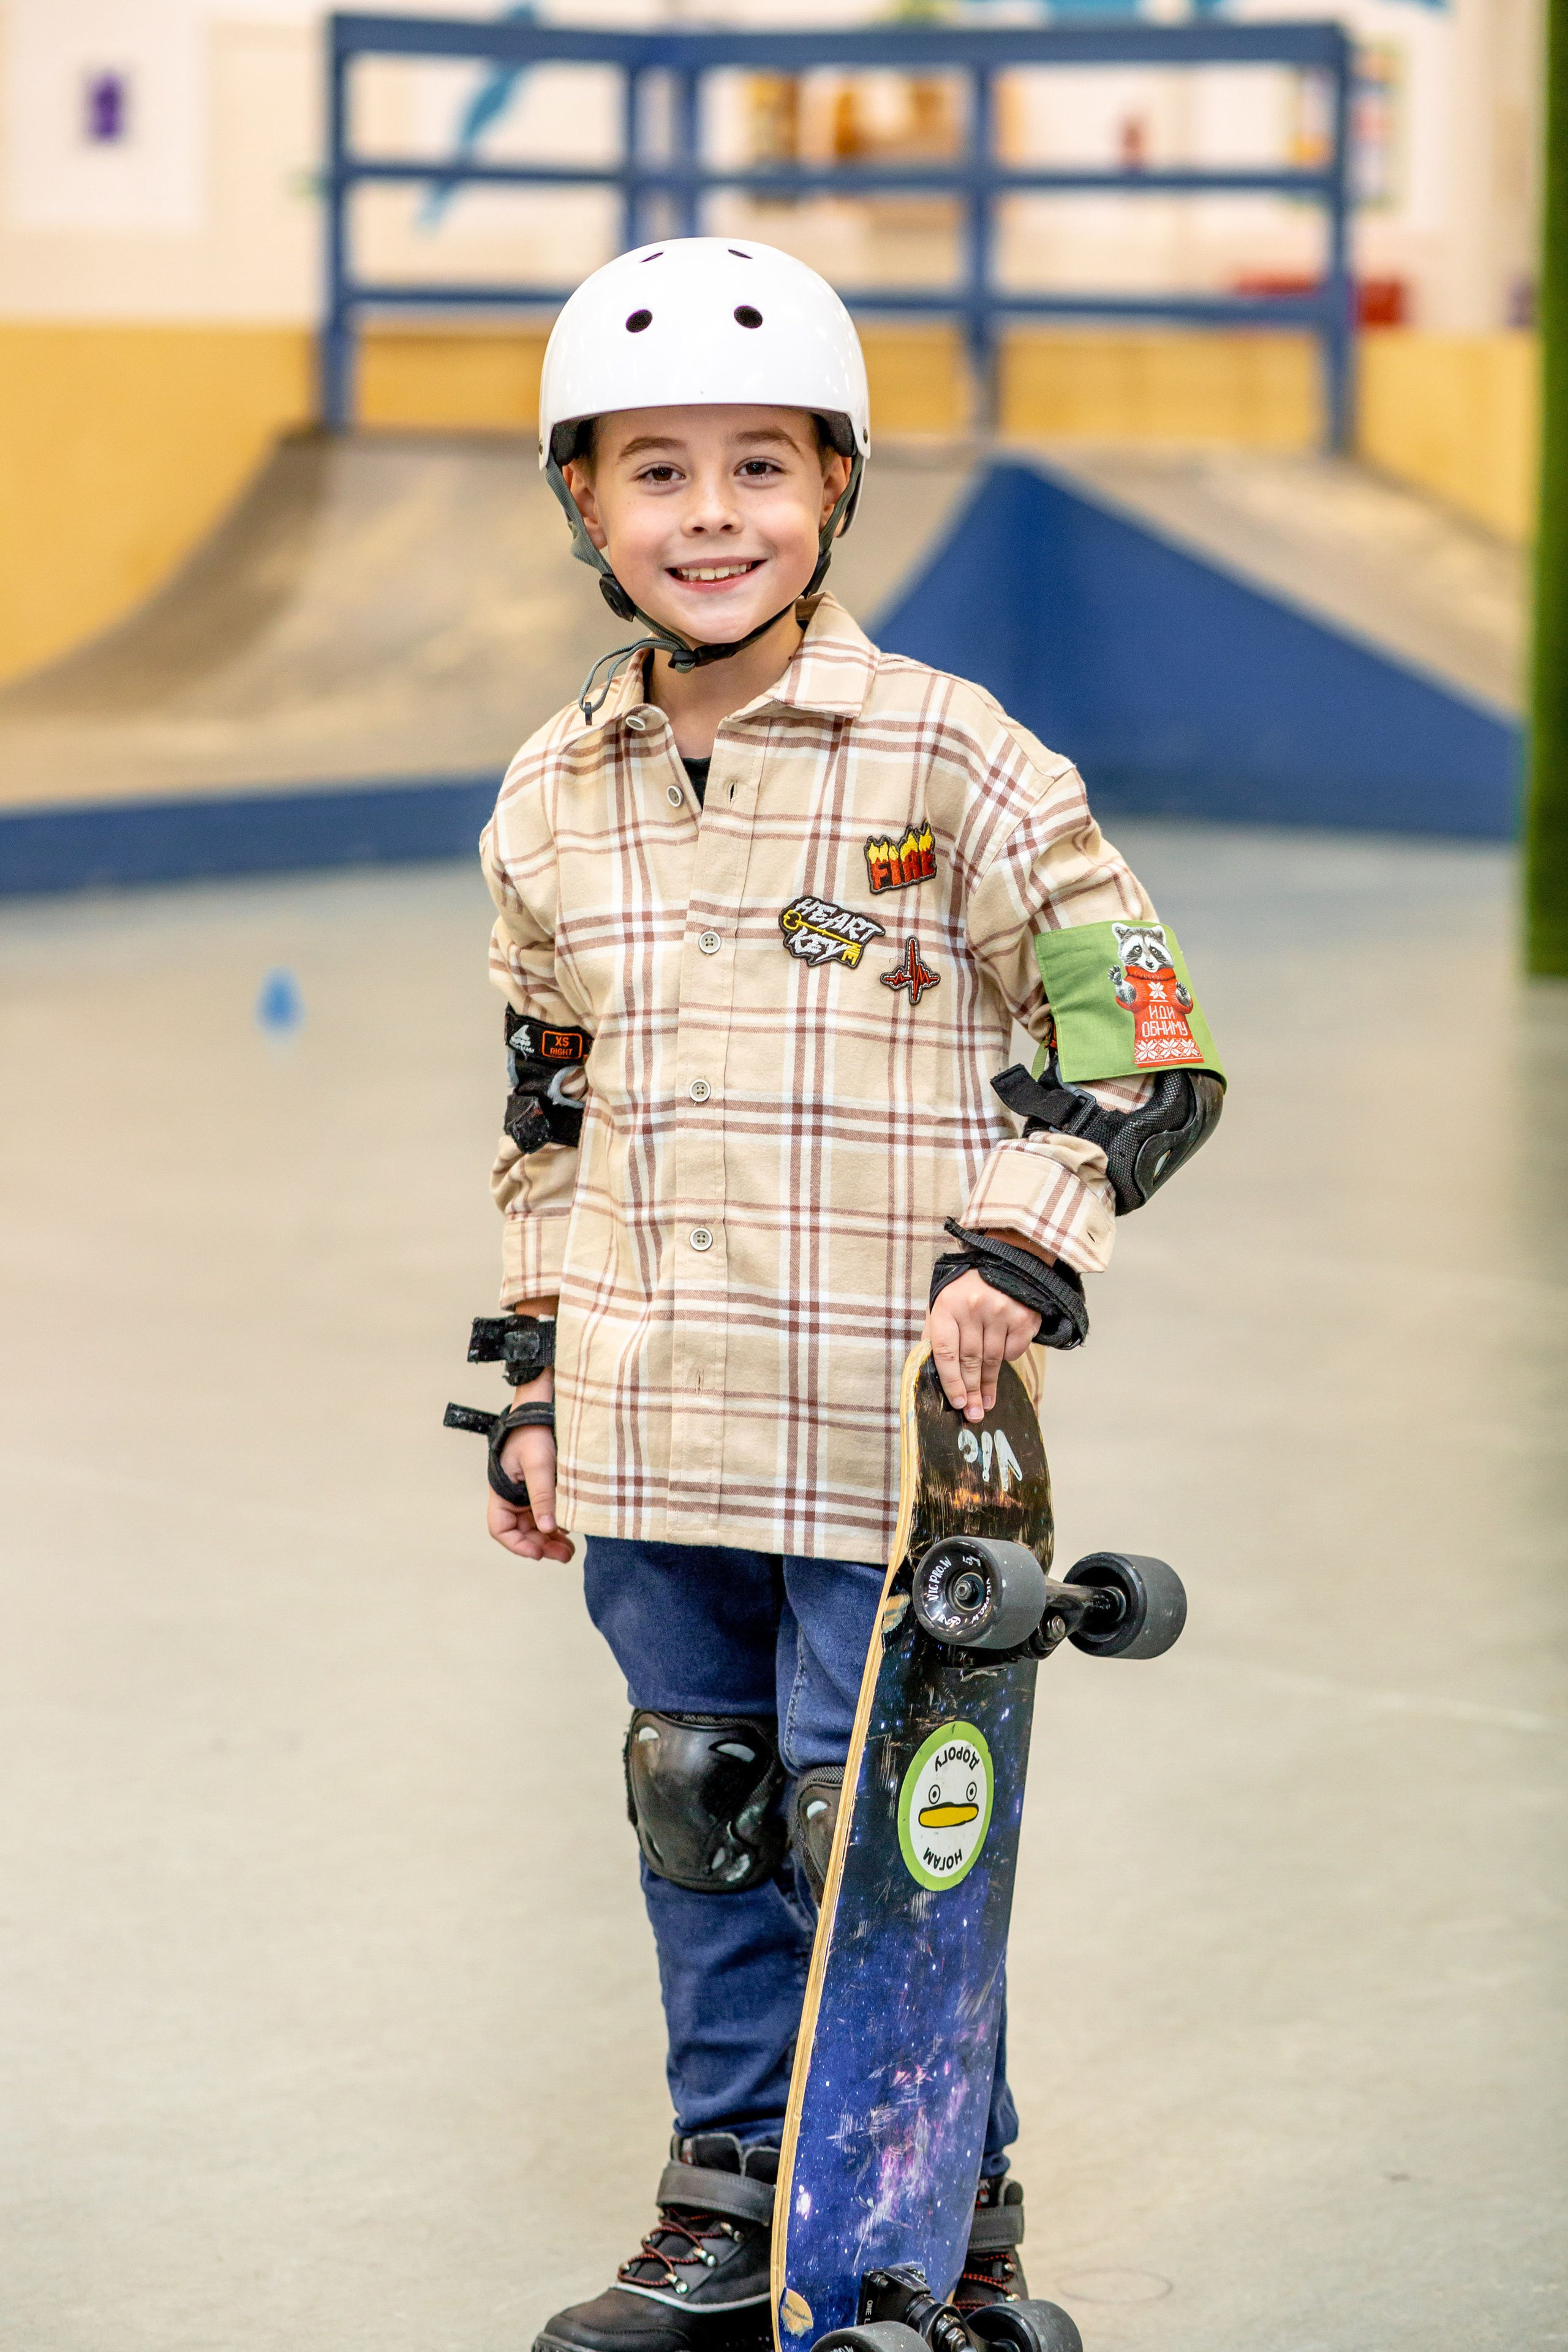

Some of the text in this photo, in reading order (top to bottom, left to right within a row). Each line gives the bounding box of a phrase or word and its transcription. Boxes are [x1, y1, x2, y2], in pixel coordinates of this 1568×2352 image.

[867, 833, 937, 891] FIRE
[793, 899, 884, 941] HEART
[788, 927, 851, 962] KEY
[1148, 1005, 1176, 1020] ИДИ
[555, 1036, 570, 1047] XS
[1142, 1020, 1188, 1038] ОБНИМУ
[935, 1746, 980, 1772] ДОРОГУ
[923, 1847, 963, 1871] НОГАМ
